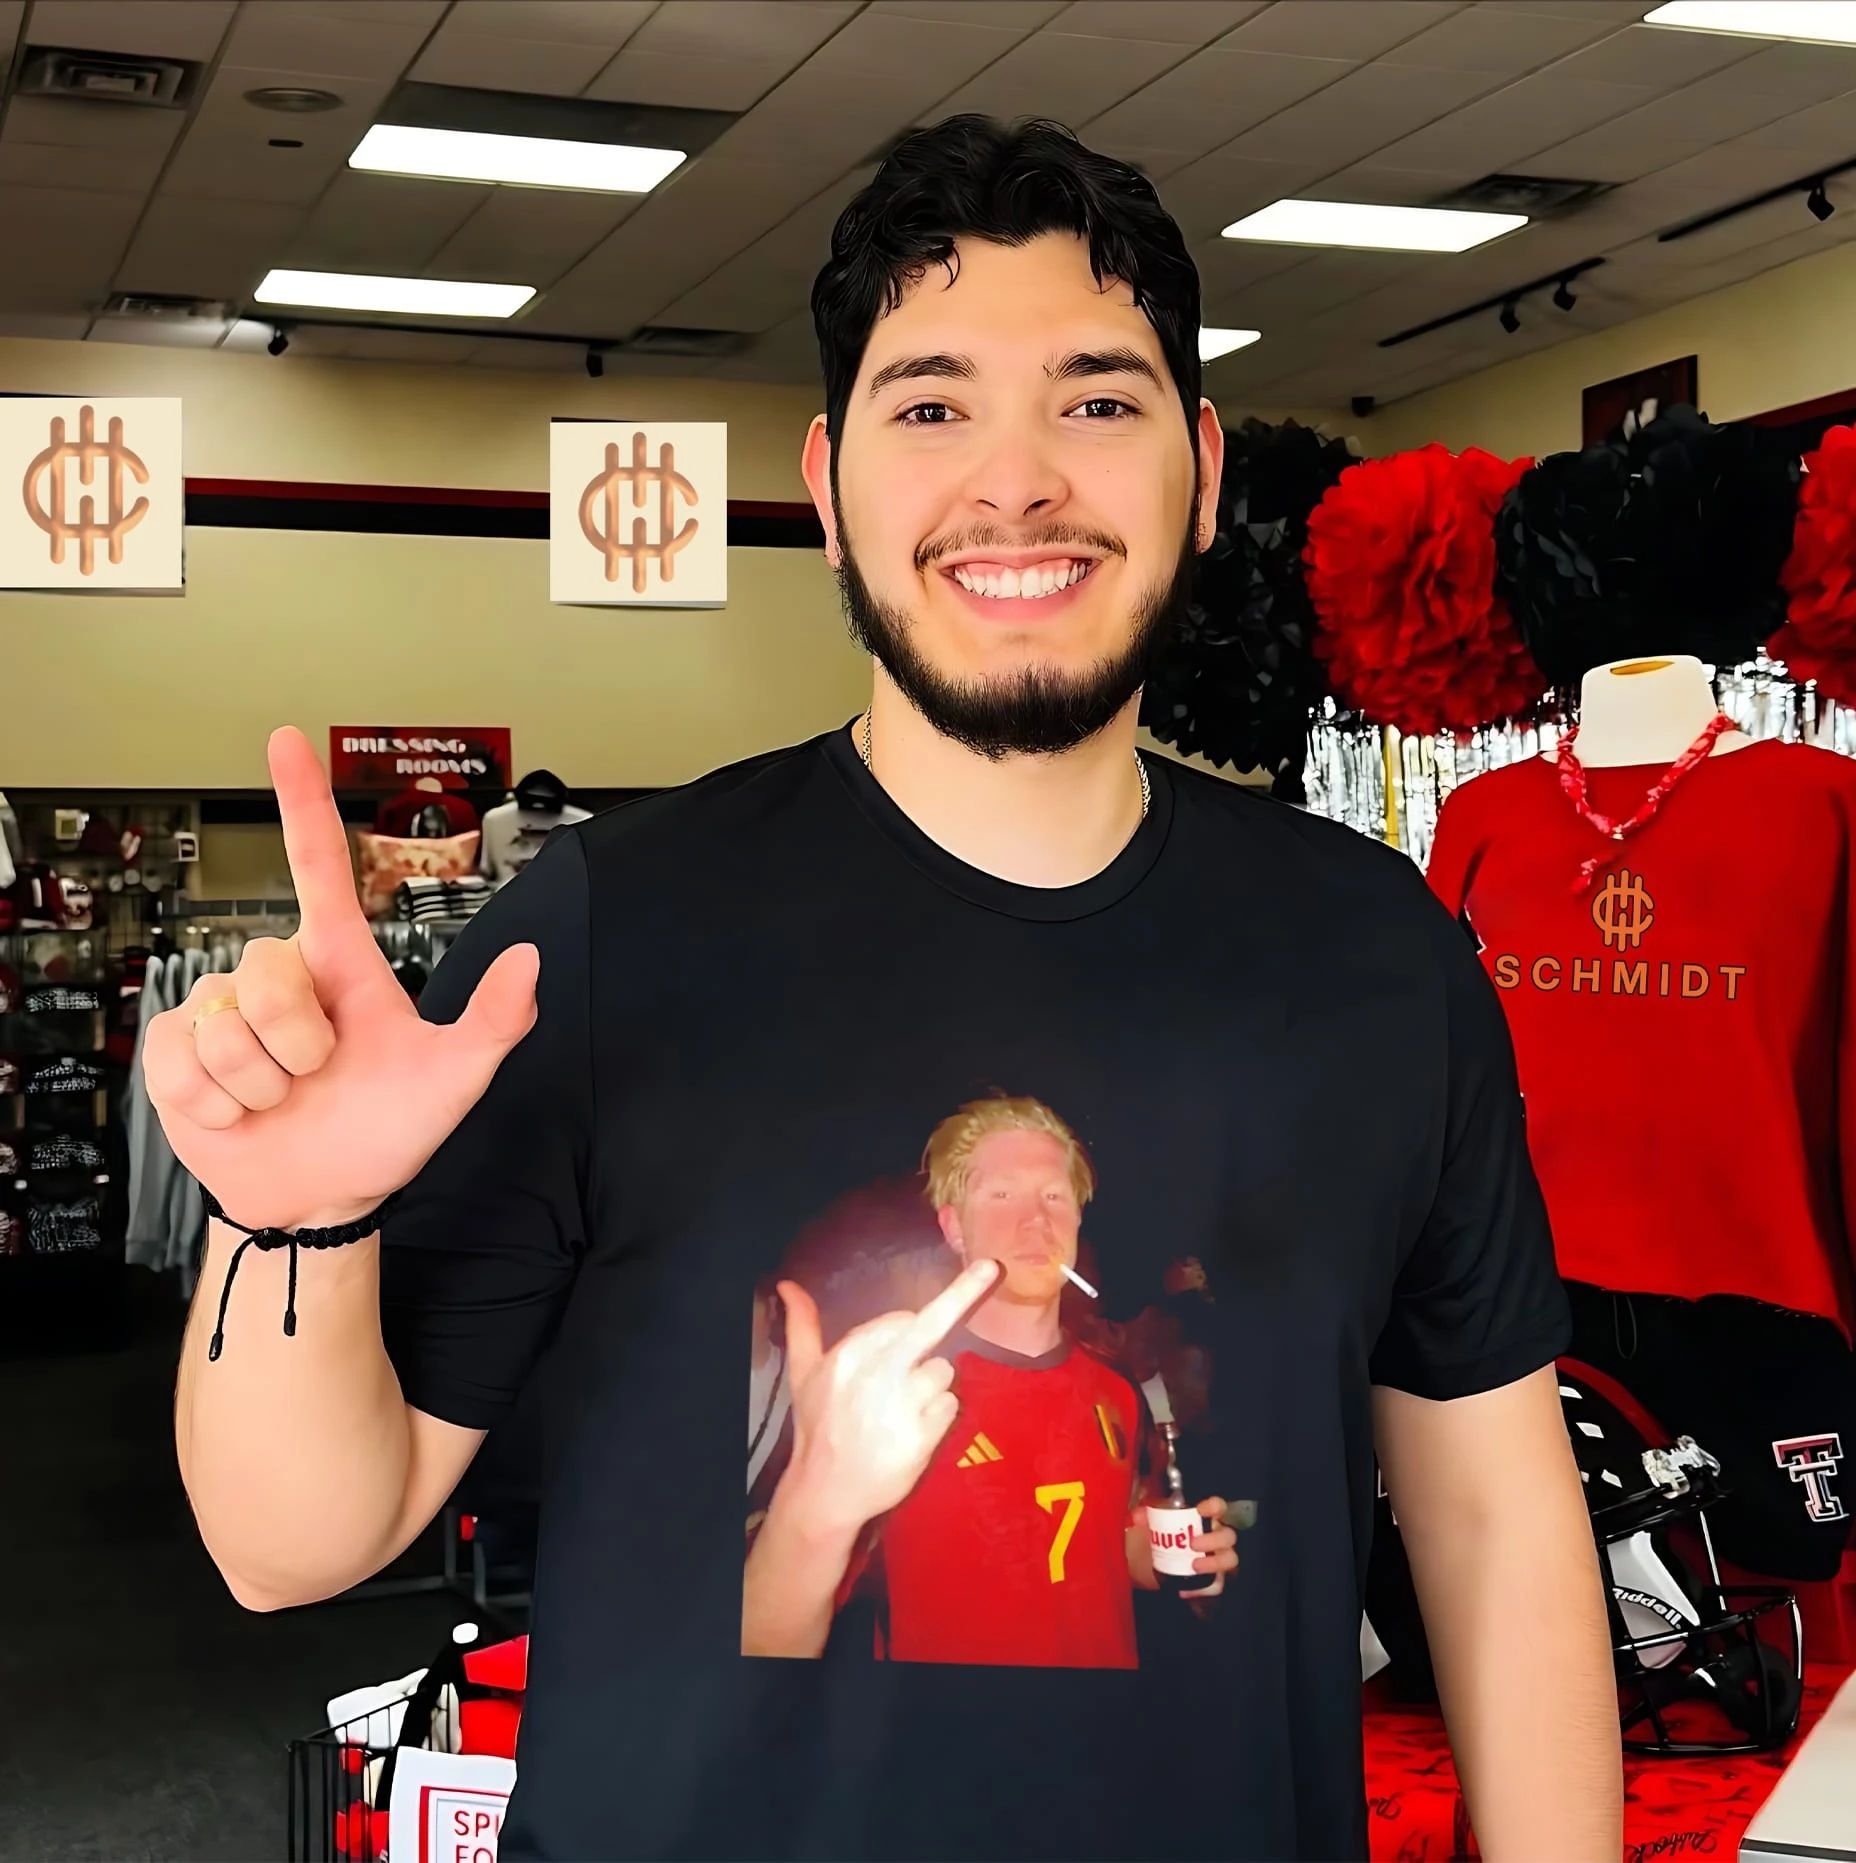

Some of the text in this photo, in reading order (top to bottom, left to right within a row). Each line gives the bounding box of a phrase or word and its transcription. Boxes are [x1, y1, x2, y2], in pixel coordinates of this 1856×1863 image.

[1494, 954, 1746, 1000] SCHMIDT
[1035, 1480, 1085, 1584] 7
[1151, 1524, 1194, 1549] uvel
